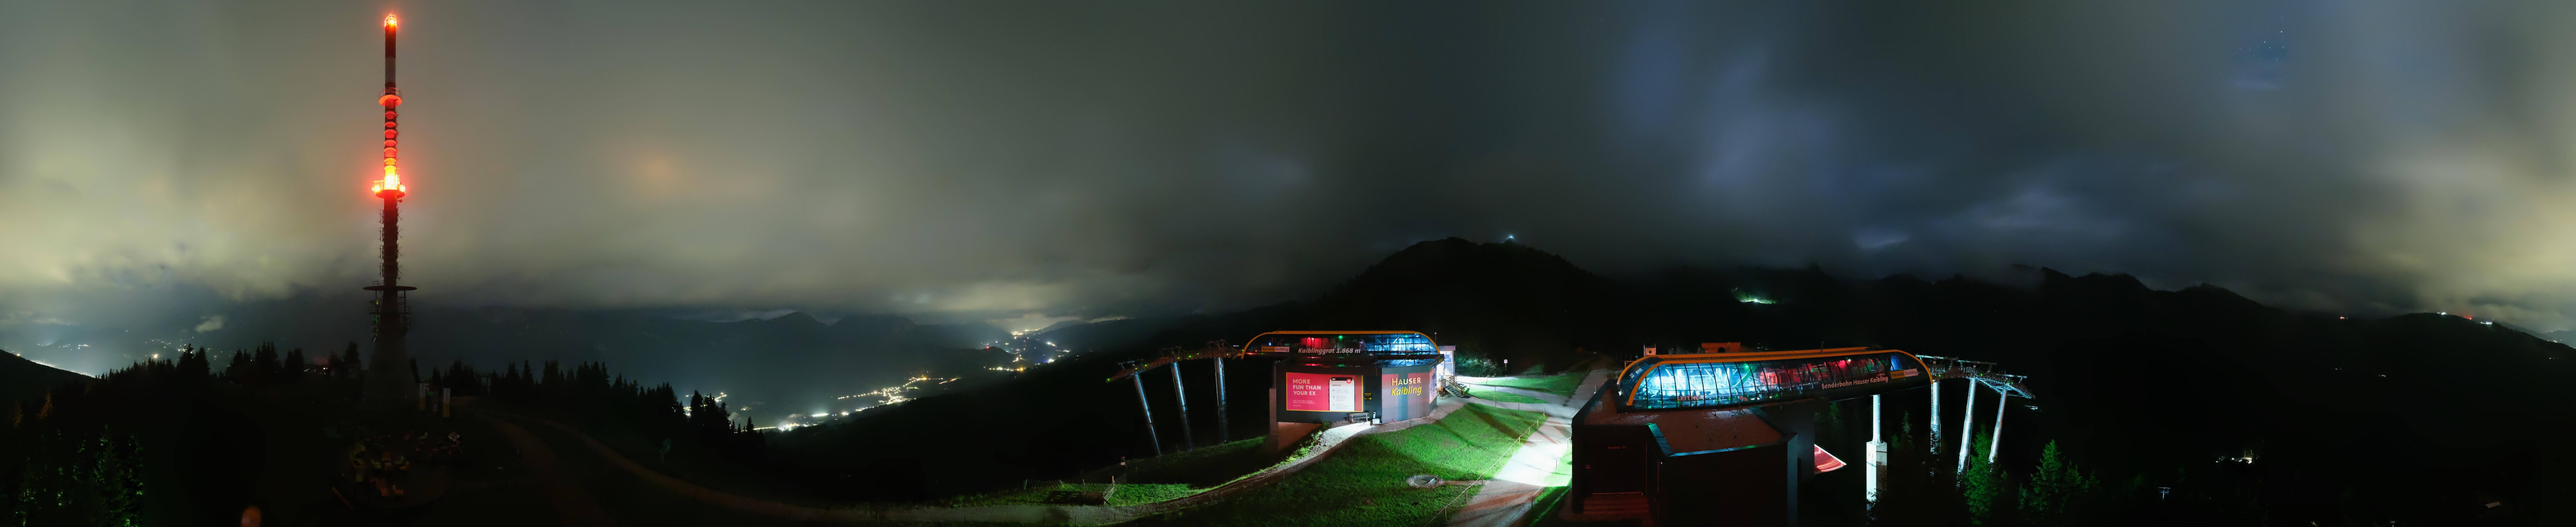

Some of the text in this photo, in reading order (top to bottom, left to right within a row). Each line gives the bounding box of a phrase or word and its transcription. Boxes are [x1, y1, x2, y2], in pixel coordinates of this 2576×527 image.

[1392, 377, 1421, 386] HAUSER
[1822, 380, 1852, 389] Senderbahn
[1391, 386, 1422, 396] Kaibling
